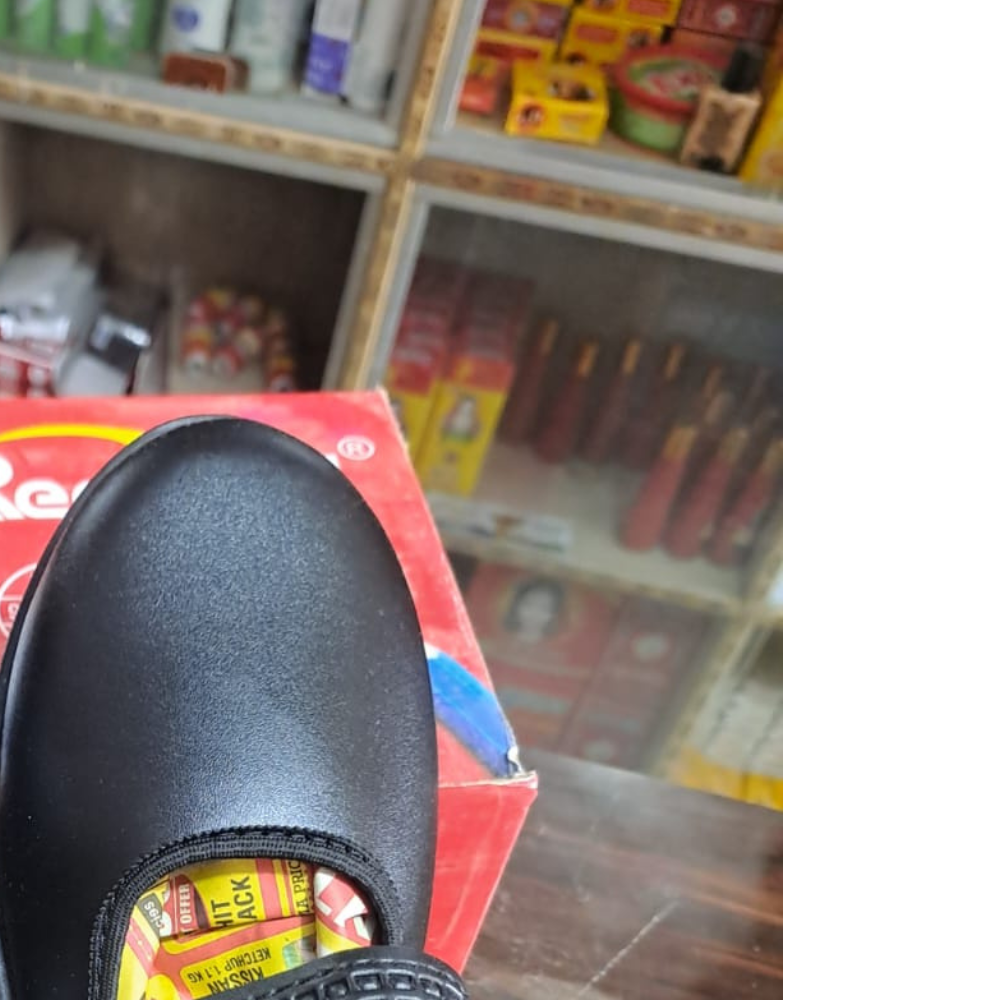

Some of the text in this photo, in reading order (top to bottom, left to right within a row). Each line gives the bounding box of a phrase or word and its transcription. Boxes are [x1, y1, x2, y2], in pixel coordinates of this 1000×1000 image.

[178, 883, 193, 924] OFFER
[187, 947, 271, 984] KETCHUP 1.1 KG
